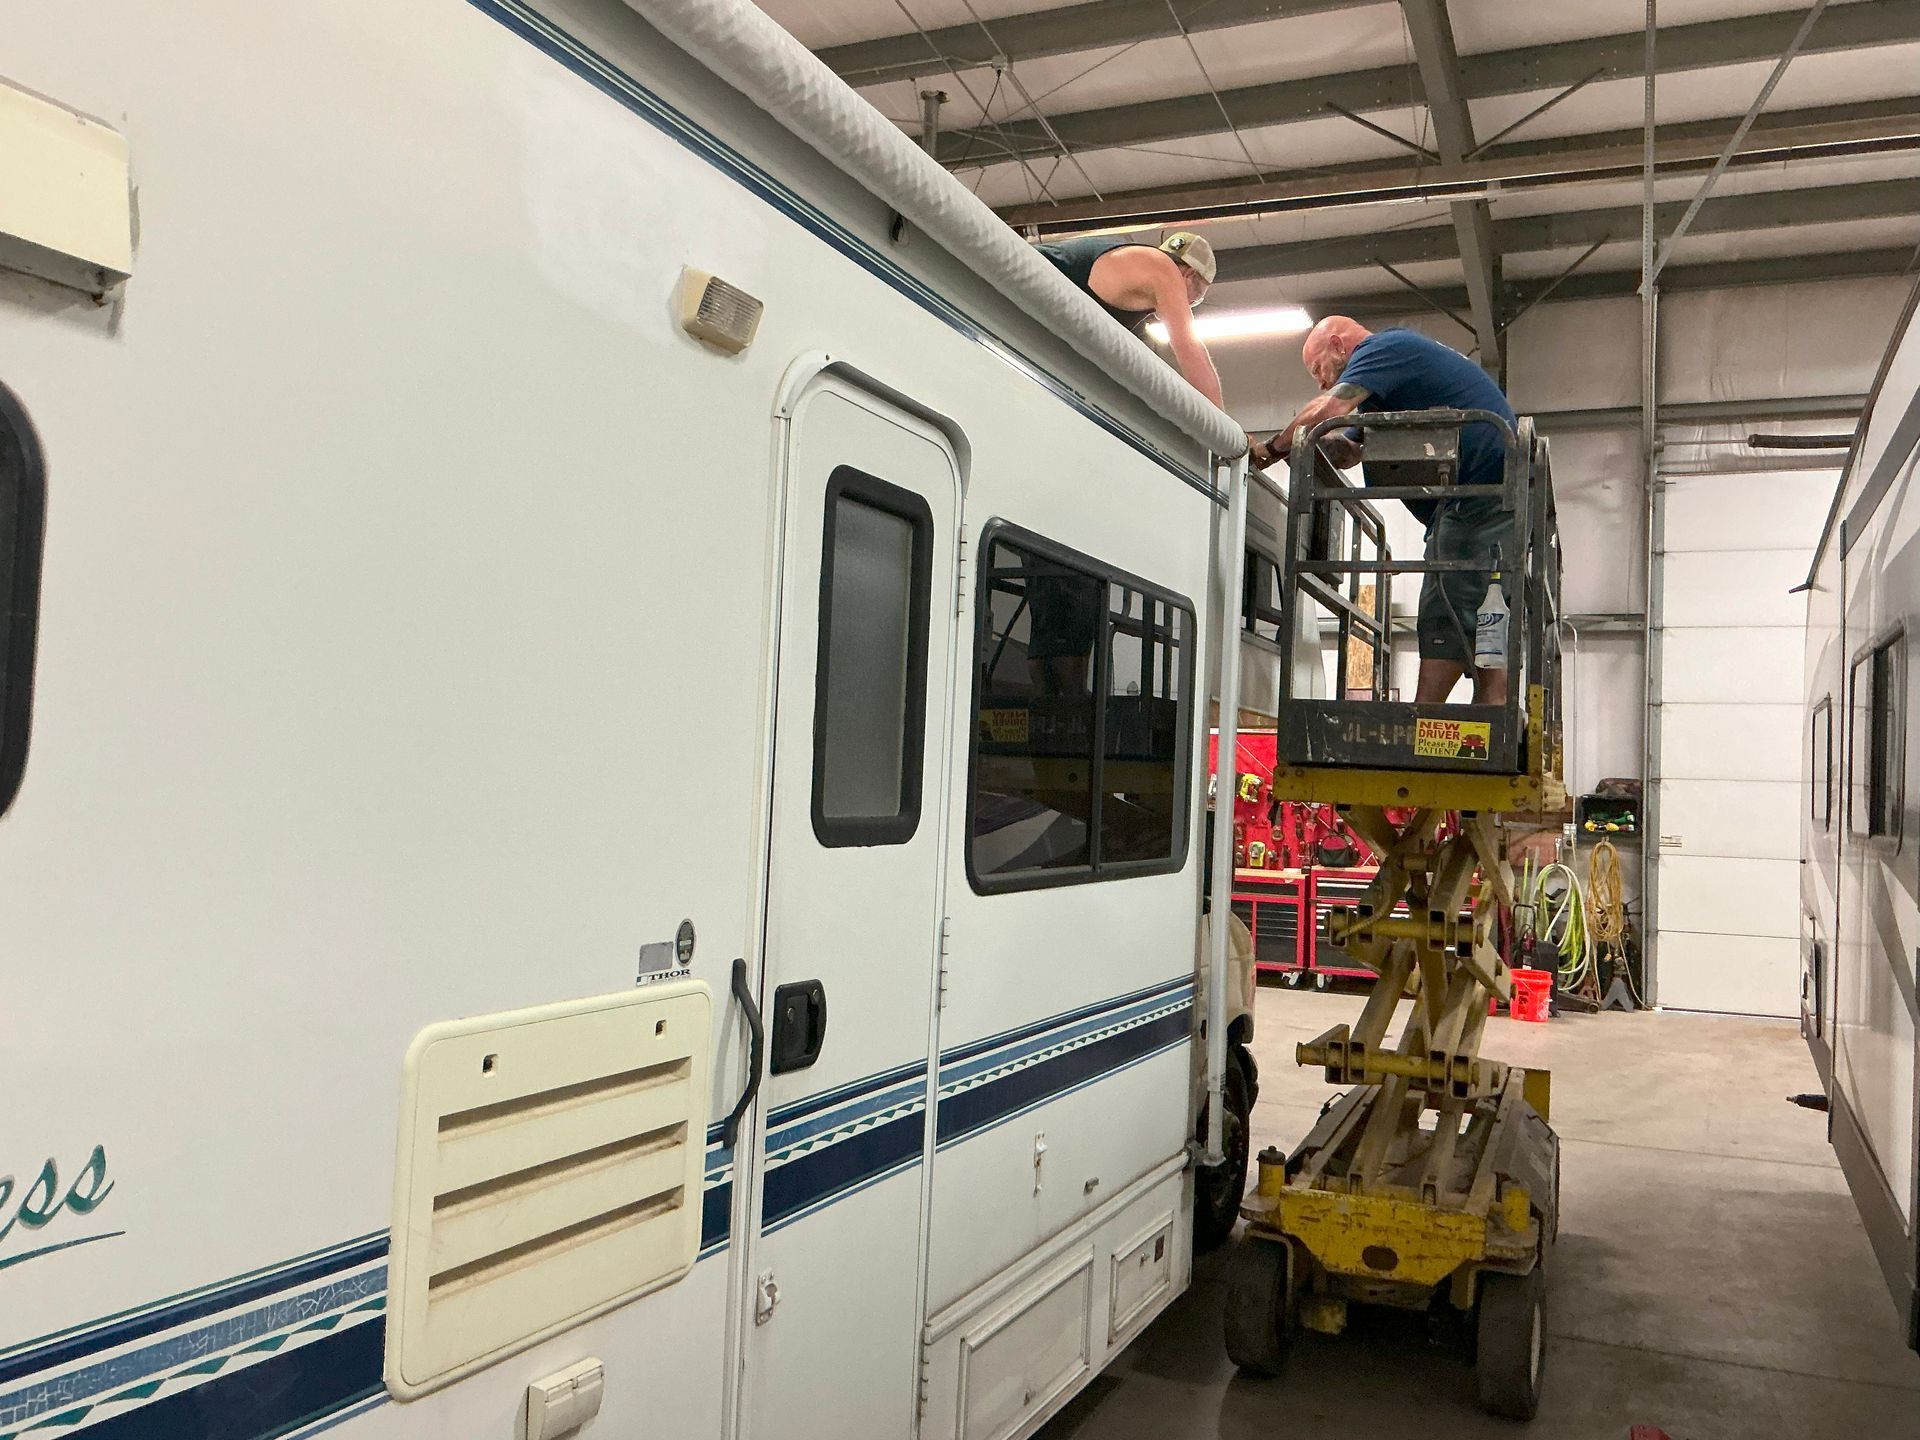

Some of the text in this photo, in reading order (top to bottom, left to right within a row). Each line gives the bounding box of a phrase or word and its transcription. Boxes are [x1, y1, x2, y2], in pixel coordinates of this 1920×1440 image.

[1419, 720, 1461, 731] NEW
[1418, 729, 1460, 740] DRIVER
[1418, 738, 1459, 749] Please Be
[1417, 746, 1457, 756] PATIENT
[648, 968, 691, 981] THOR
